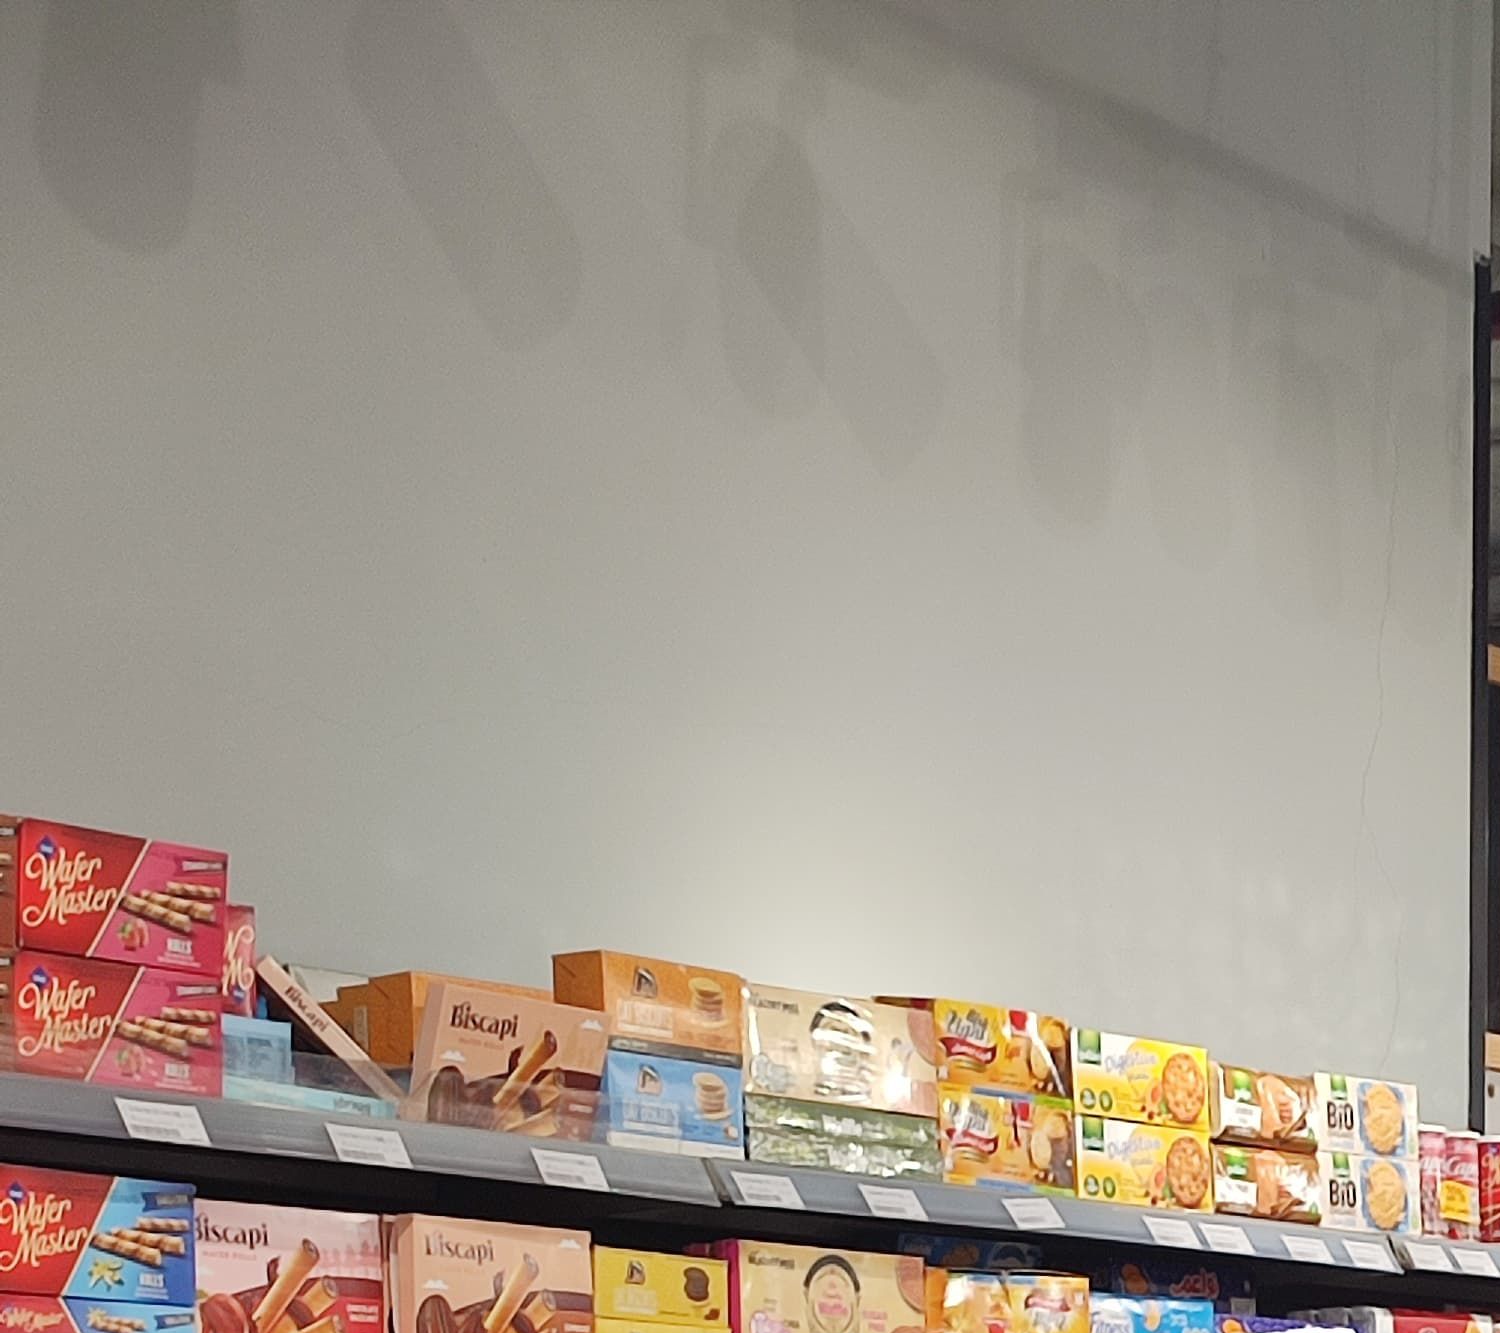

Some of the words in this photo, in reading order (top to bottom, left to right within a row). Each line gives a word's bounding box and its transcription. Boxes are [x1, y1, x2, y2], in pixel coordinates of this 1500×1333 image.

[25, 847, 101, 891] Wafer
[23, 885, 117, 926] Master
[18, 976, 95, 1020] Wafer
[284, 986, 331, 1033] Biscapi
[18, 1014, 111, 1056] Master
[450, 1002, 519, 1040] Biscapi
[0, 1191, 71, 1236] Wafer
[0, 1227, 88, 1272] Master
